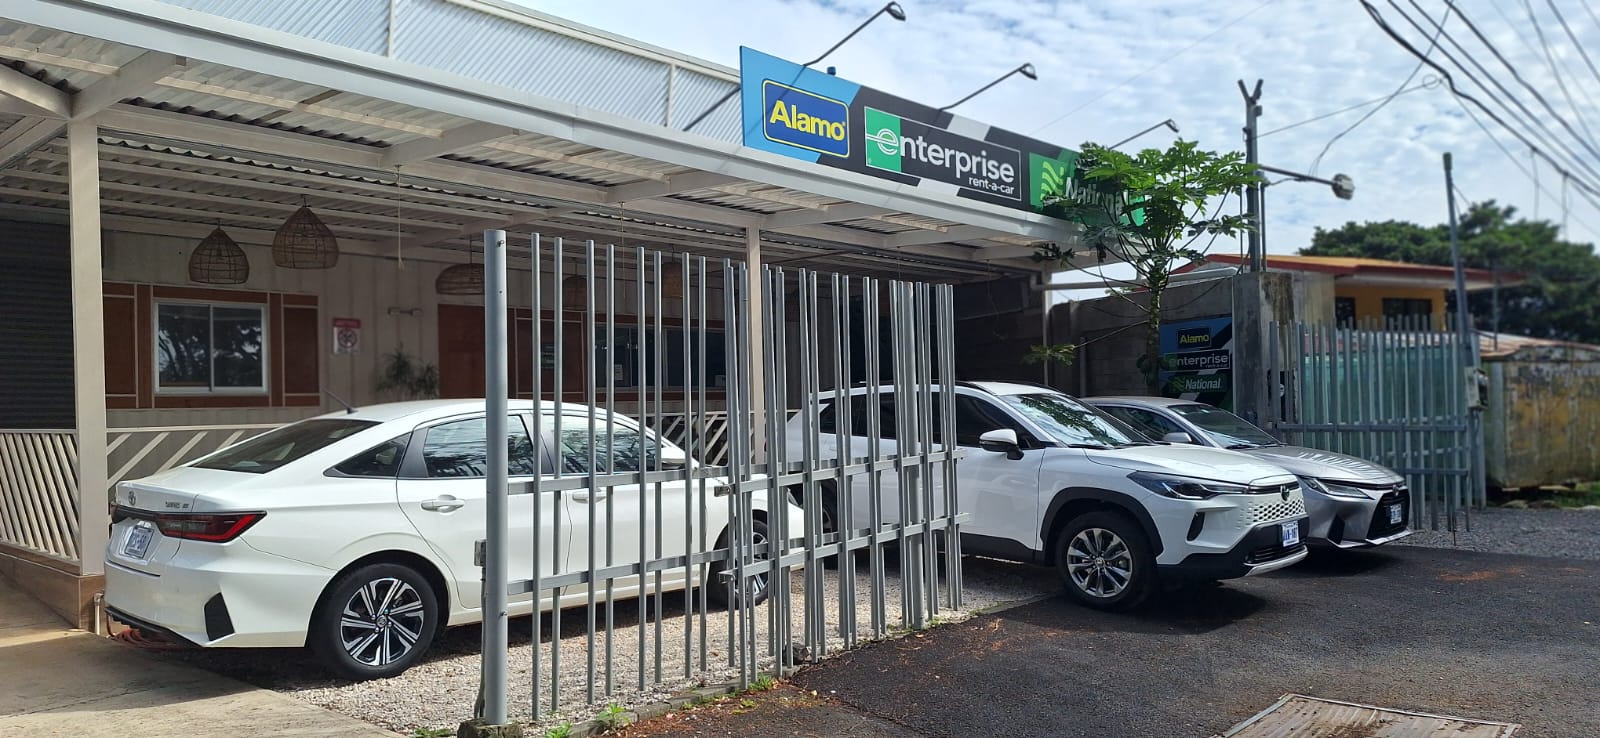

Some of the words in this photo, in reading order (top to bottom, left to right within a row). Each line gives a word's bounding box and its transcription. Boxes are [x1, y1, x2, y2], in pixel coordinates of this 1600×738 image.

[769, 99, 846, 142] Alamo
[866, 128, 1015, 183] enterprise
[968, 175, 1015, 196] rent-a-car
[1180, 334, 1209, 344] Alamo
[1168, 353, 1228, 367] enterprise
[1185, 378, 1221, 390] National
